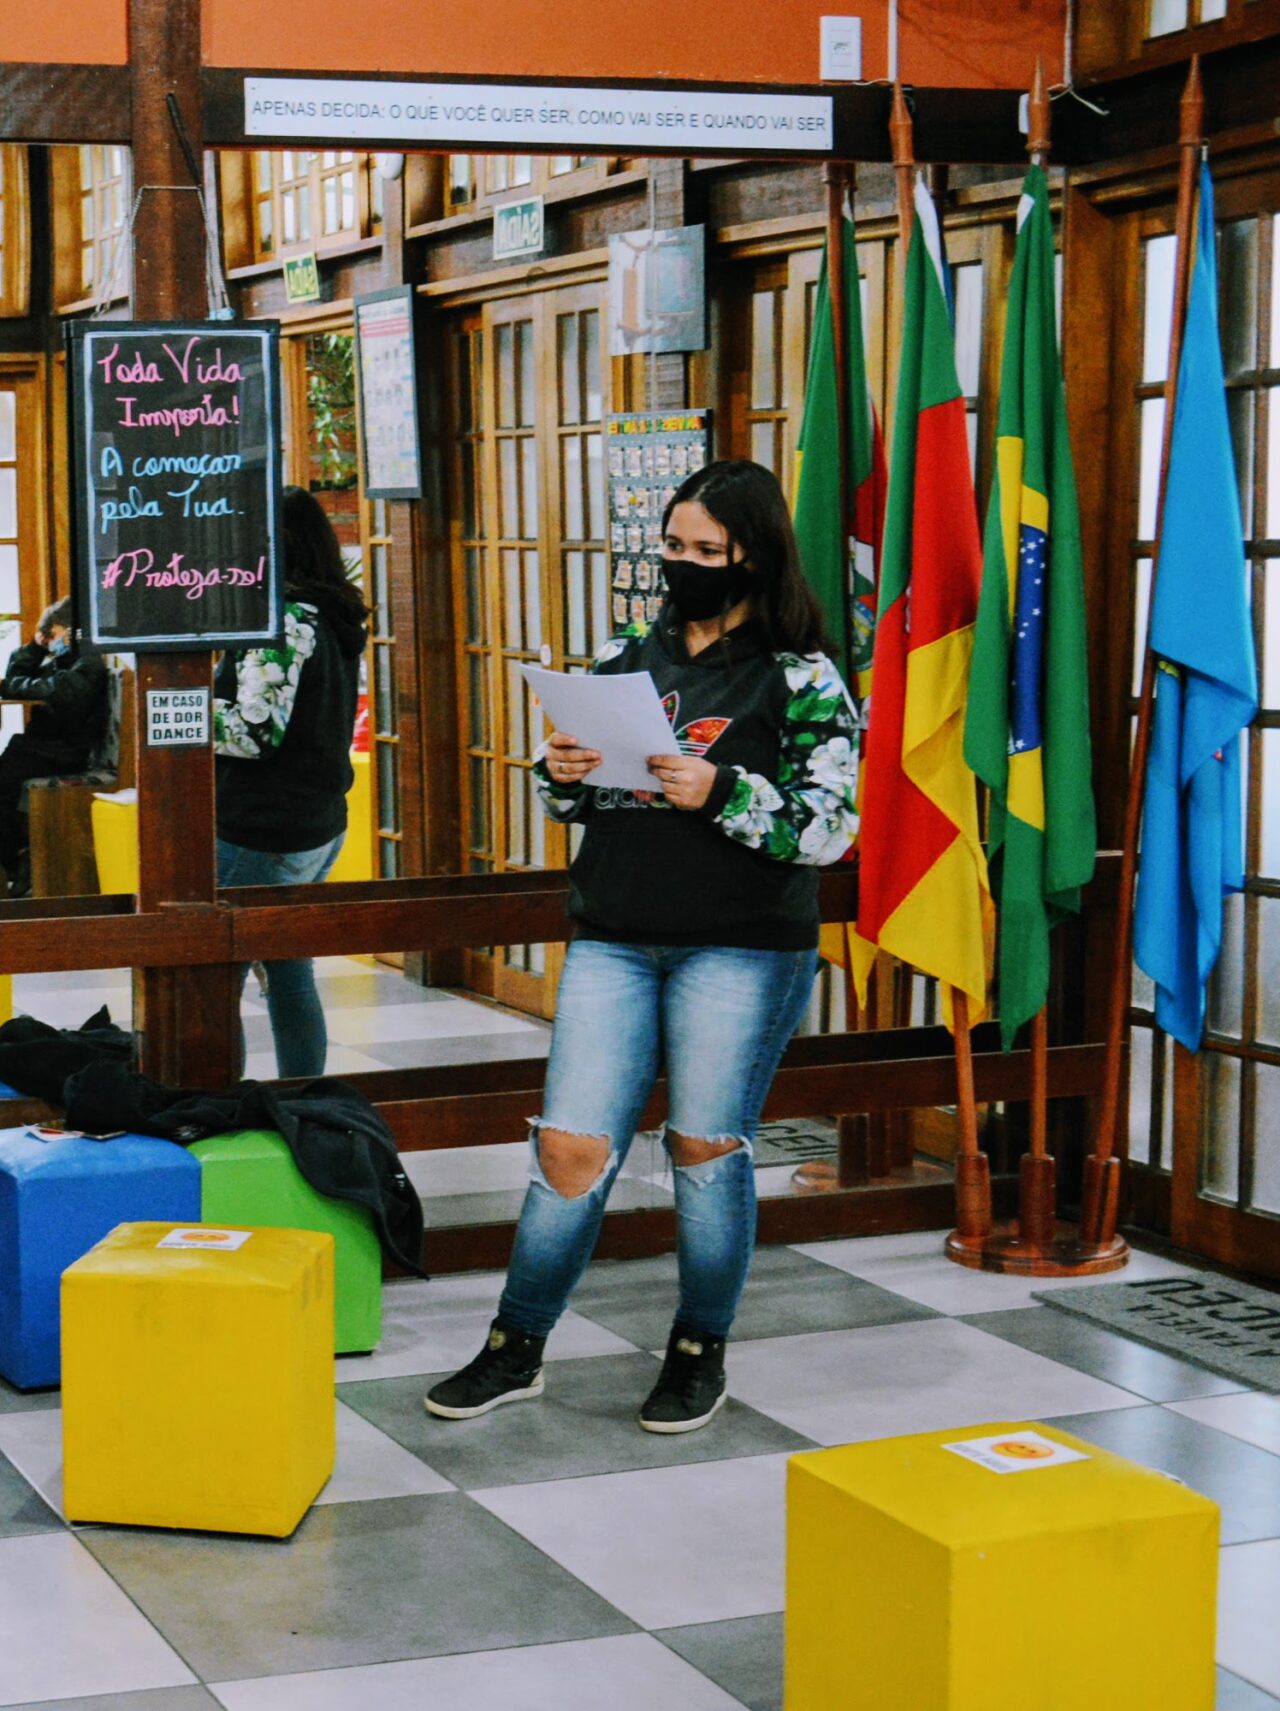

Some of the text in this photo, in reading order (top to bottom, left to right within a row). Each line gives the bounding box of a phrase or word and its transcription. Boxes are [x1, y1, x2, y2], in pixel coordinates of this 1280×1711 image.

[252, 101, 826, 131] APENAS DECIDA: O QUE VOCÊ QUER SER, COMO VAI SER E QUANDO VAI SER
[97, 336, 246, 384] Toda Vida
[116, 394, 240, 437] Importa!
[101, 446, 242, 478] A começar
[100, 485, 164, 534] pela
[152, 695, 203, 707] EM CASO
[152, 712, 203, 724] DE DOR
[152, 728, 204, 740] DANCE
